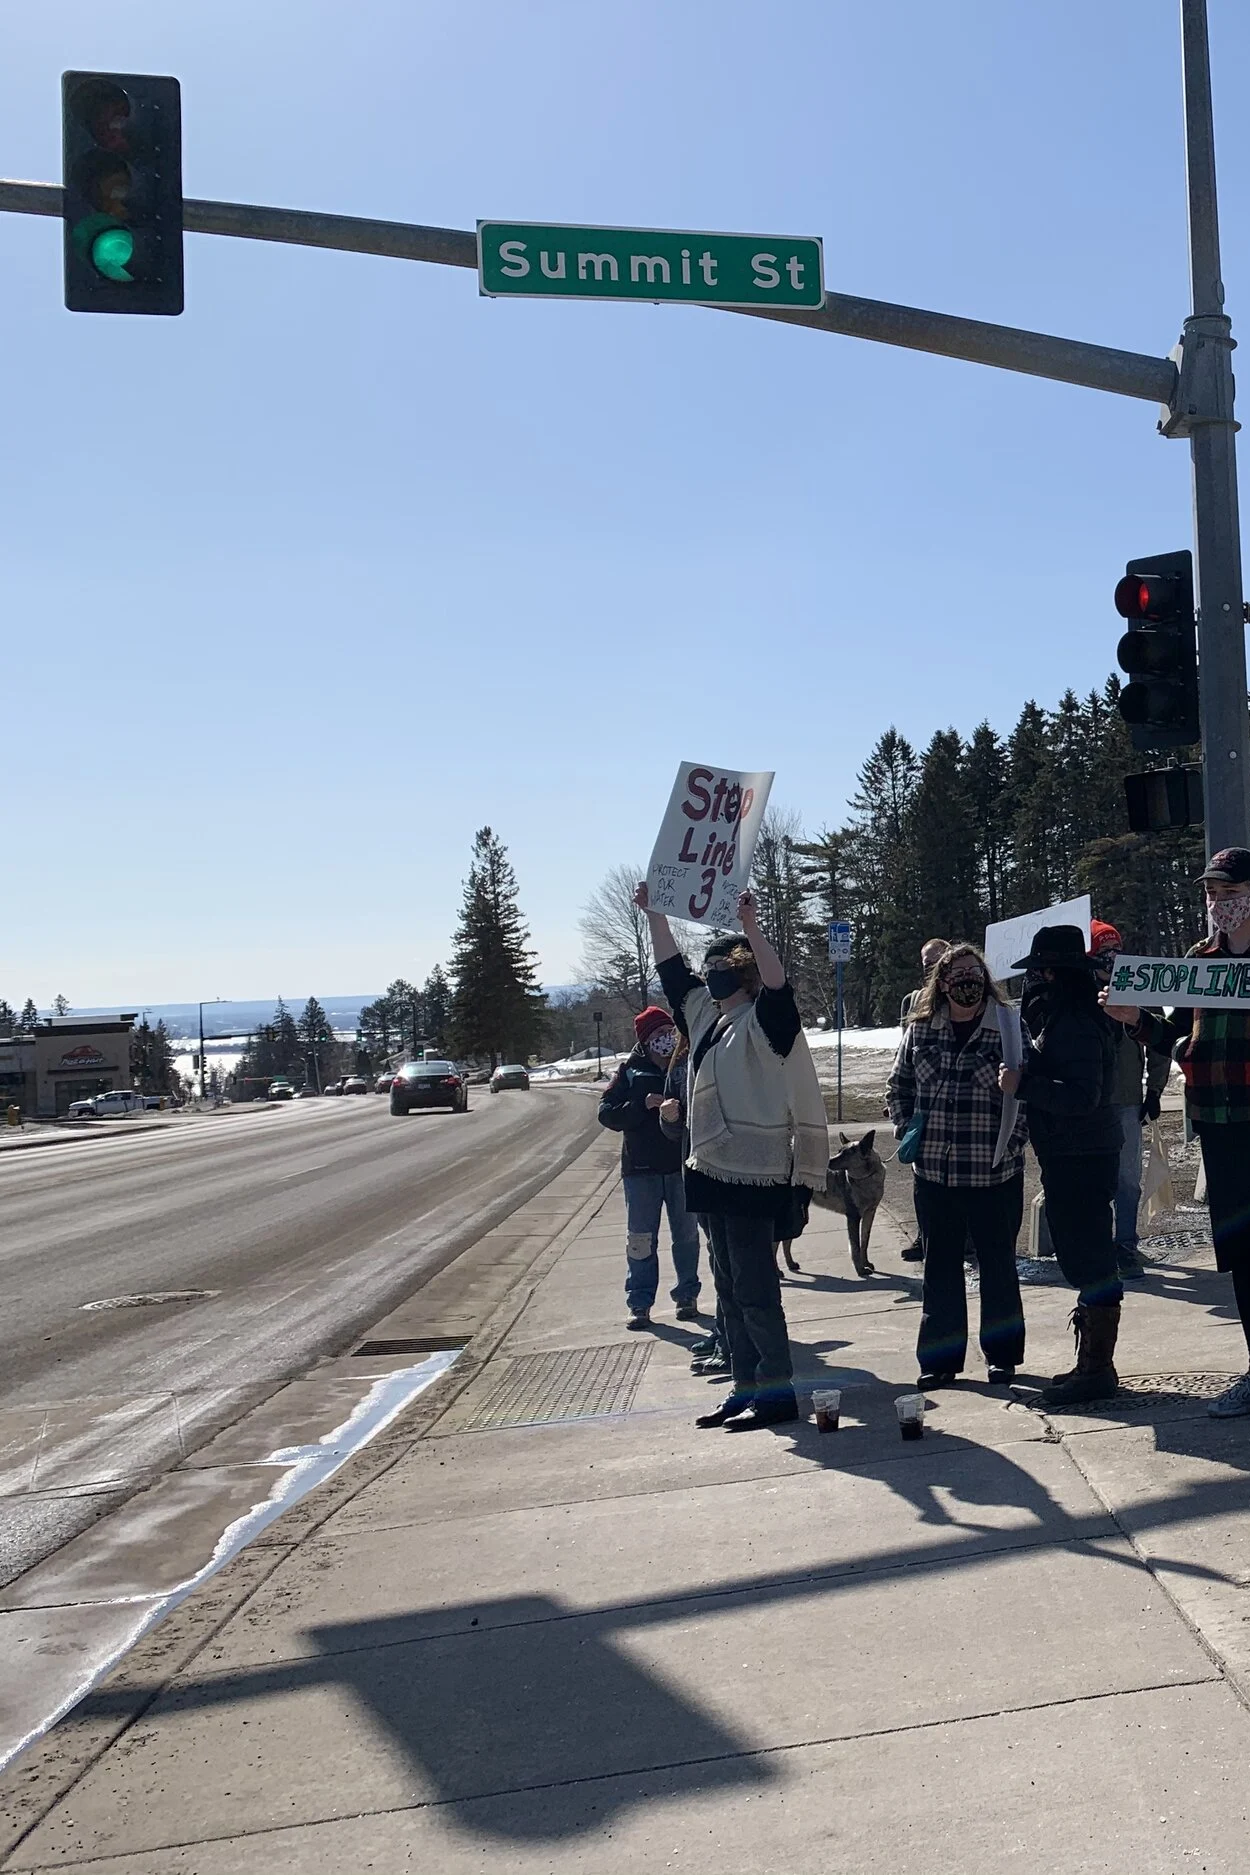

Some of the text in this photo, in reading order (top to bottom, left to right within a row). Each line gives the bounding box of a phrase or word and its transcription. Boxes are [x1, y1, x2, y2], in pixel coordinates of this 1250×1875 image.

[498, 240, 806, 290] Summit St
[680, 767, 755, 842] Stop
[678, 826, 736, 876] Line
[688, 867, 717, 919] 3
